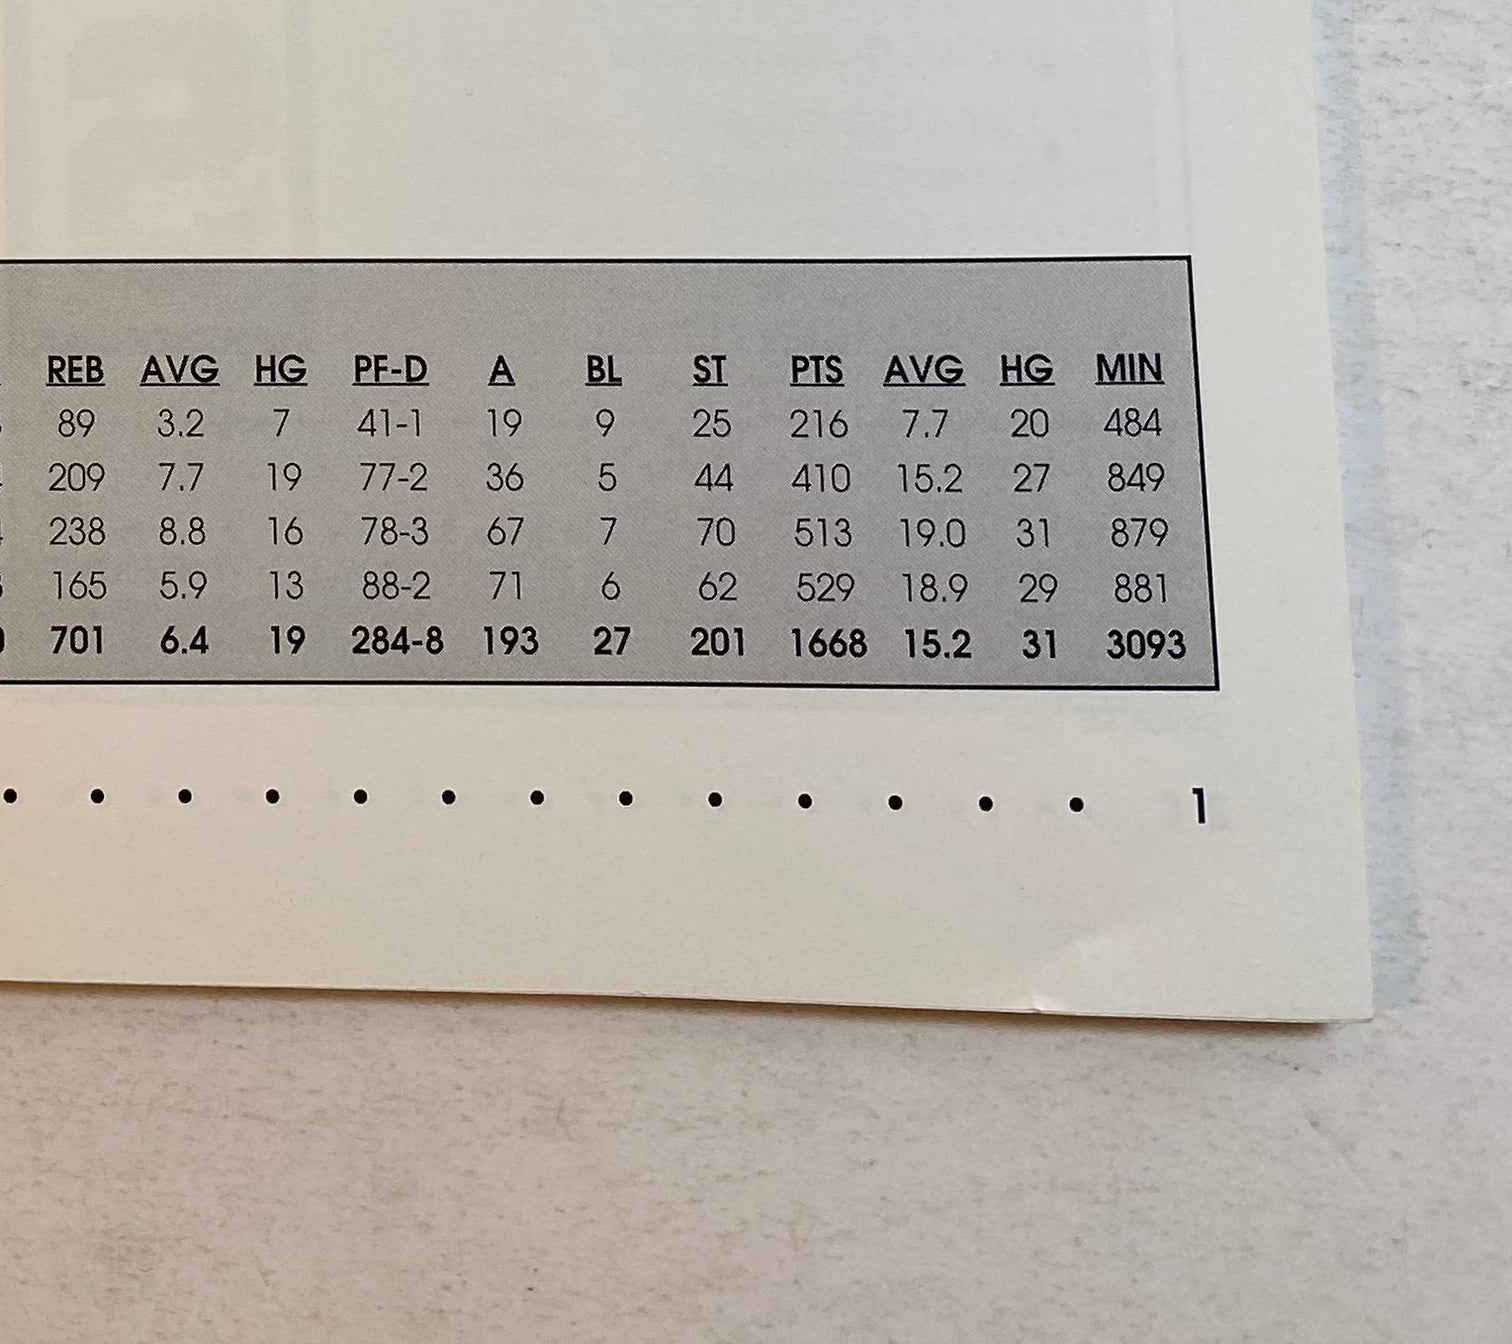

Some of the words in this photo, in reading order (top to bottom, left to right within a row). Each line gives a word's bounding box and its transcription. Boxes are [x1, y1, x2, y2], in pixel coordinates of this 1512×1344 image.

[46, 355, 105, 382] REB
[139, 354, 221, 382] AVG
[254, 354, 308, 382] HG
[352, 354, 430, 382] PF-D
[488, 355, 516, 382] A
[585, 355, 622, 382] BL
[692, 355, 728, 383] ST
[790, 355, 845, 383] PTS
[883, 355, 966, 383] AVG
[999, 354, 1055, 382] HG
[1095, 352, 1165, 381] MIN
[58, 409, 95, 437] 89
[158, 409, 204, 437] 3.2
[273, 409, 290, 437] 7
[358, 409, 419, 437] 41-1
[487, 409, 522, 437] 19
[596, 408, 615, 437] 9
[693, 409, 731, 437] 25
[790, 409, 848, 438] 216
[903, 409, 948, 438] 7.7
[1011, 408, 1049, 438] 20
[1104, 408, 1162, 437] 484
[51, 626, 102, 654] 701
[161, 625, 209, 654] 6.4
[271, 625, 305, 654] 19
[352, 626, 443, 655] 284-8
[484, 626, 539, 655] 193
[594, 626, 630, 655] 27
[691, 627, 744, 656] 201
[792, 628, 867, 658] 1668
[905, 629, 971, 659] 15.2
[1023, 629, 1056, 659] 31
[1107, 629, 1187, 659] 3093
[1192, 788, 1205, 824] 1
